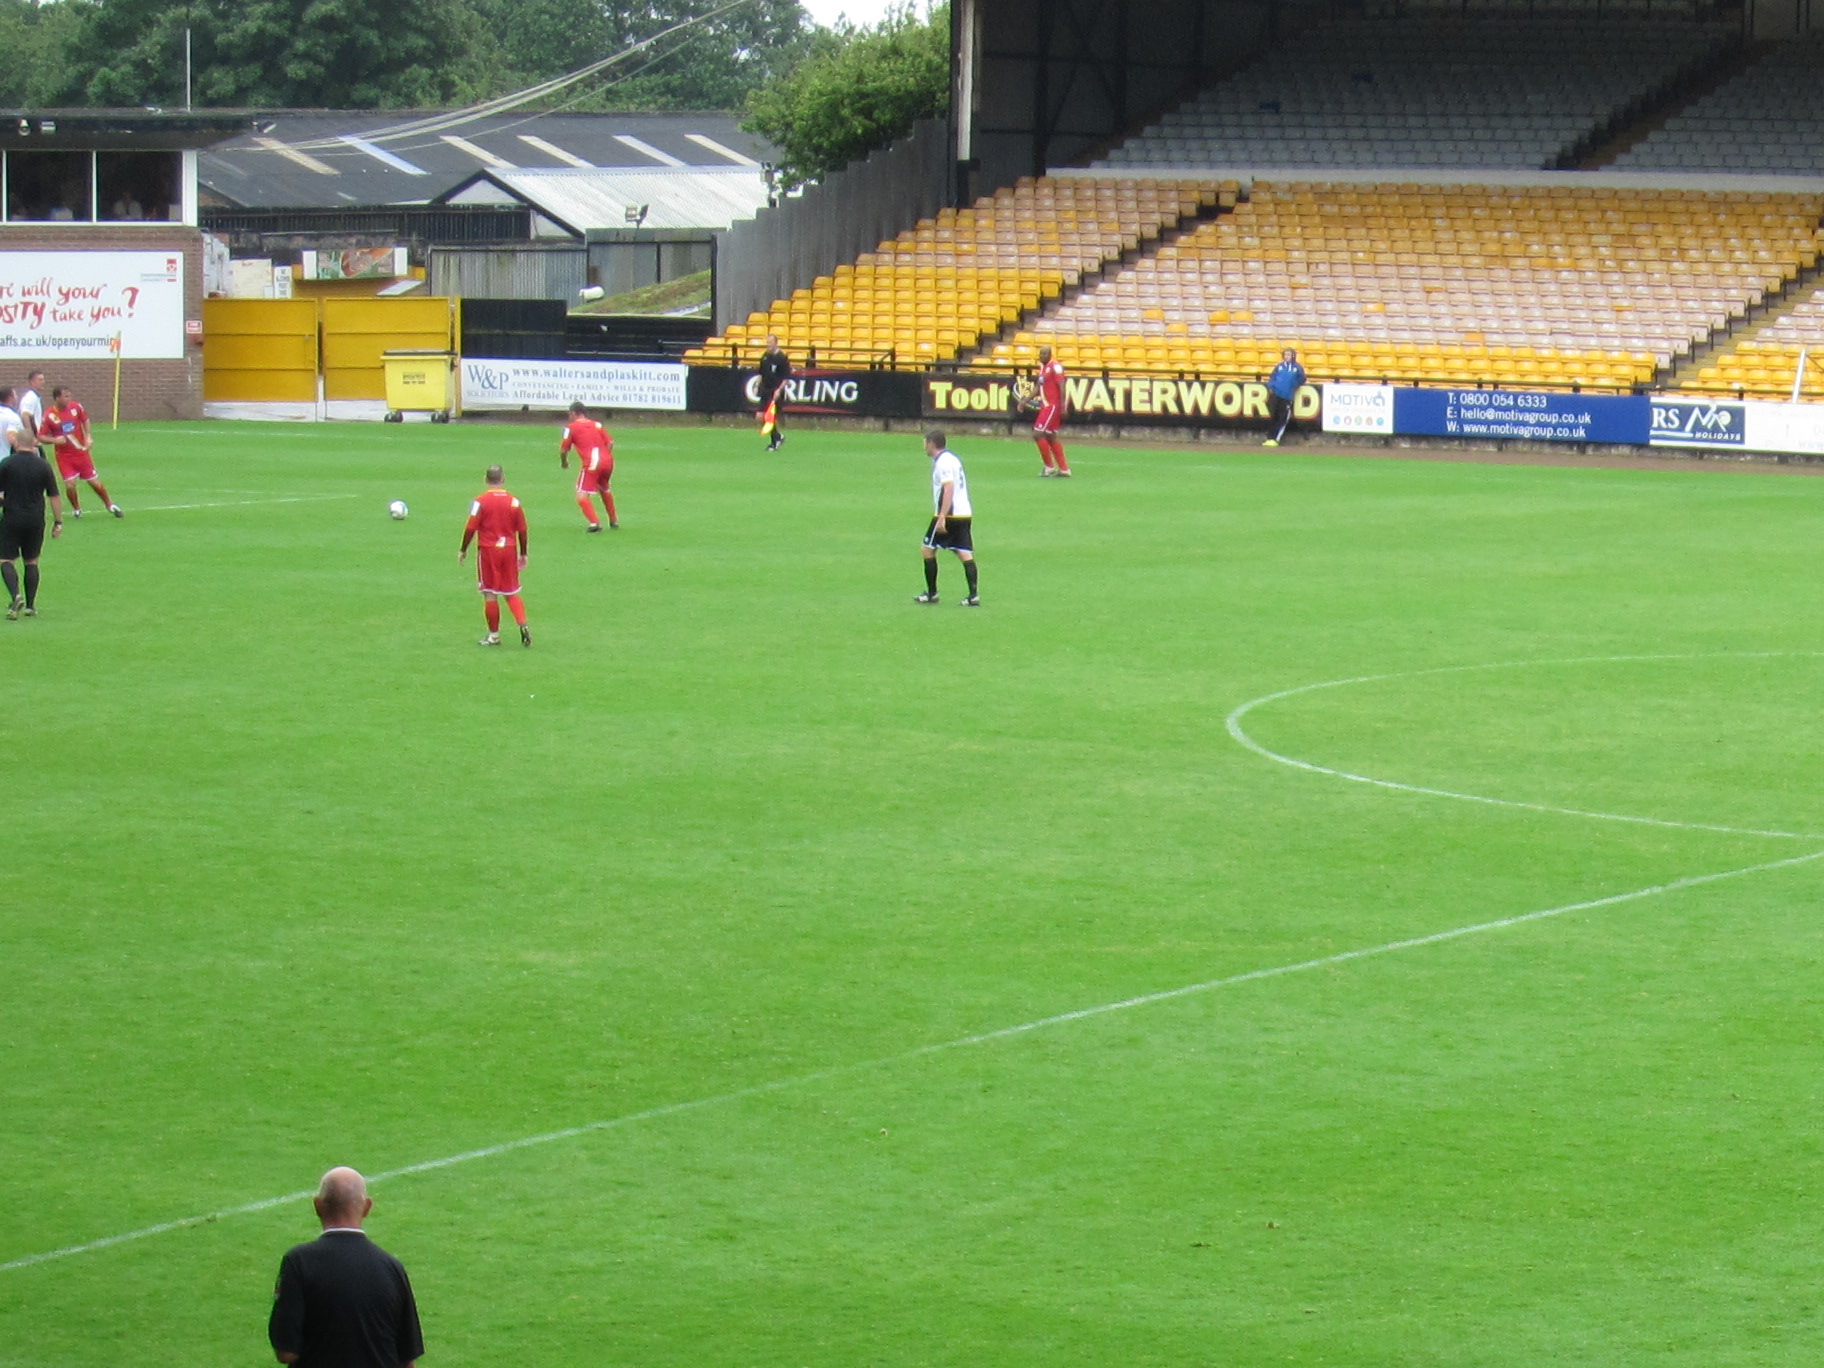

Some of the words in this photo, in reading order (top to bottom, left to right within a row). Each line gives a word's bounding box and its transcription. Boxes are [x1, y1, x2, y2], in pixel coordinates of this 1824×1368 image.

[21, 277, 53, 298] will
[56, 284, 108, 306] your
[51, 306, 84, 323] take
[467, 365, 510, 390] W&P
[512, 367, 681, 383] www.waltersandplaskitt.com
[512, 390, 560, 401] Affordable
[590, 392, 620, 402] Advice
[622, 393, 649, 403] 01782
[745, 374, 859, 403] CRLING
[1064, 377, 1320, 419] WATERWORD
[1460, 393, 1489, 405] 0800
[1492, 393, 1514, 406] 054
[1517, 395, 1547, 408] 6333
[1460, 408, 1591, 424] hello@motivagroup.co.uk
[1463, 423, 1586, 438] www.motivagroup.co.uk
[1695, 431, 1741, 441] HOLIDAYS
